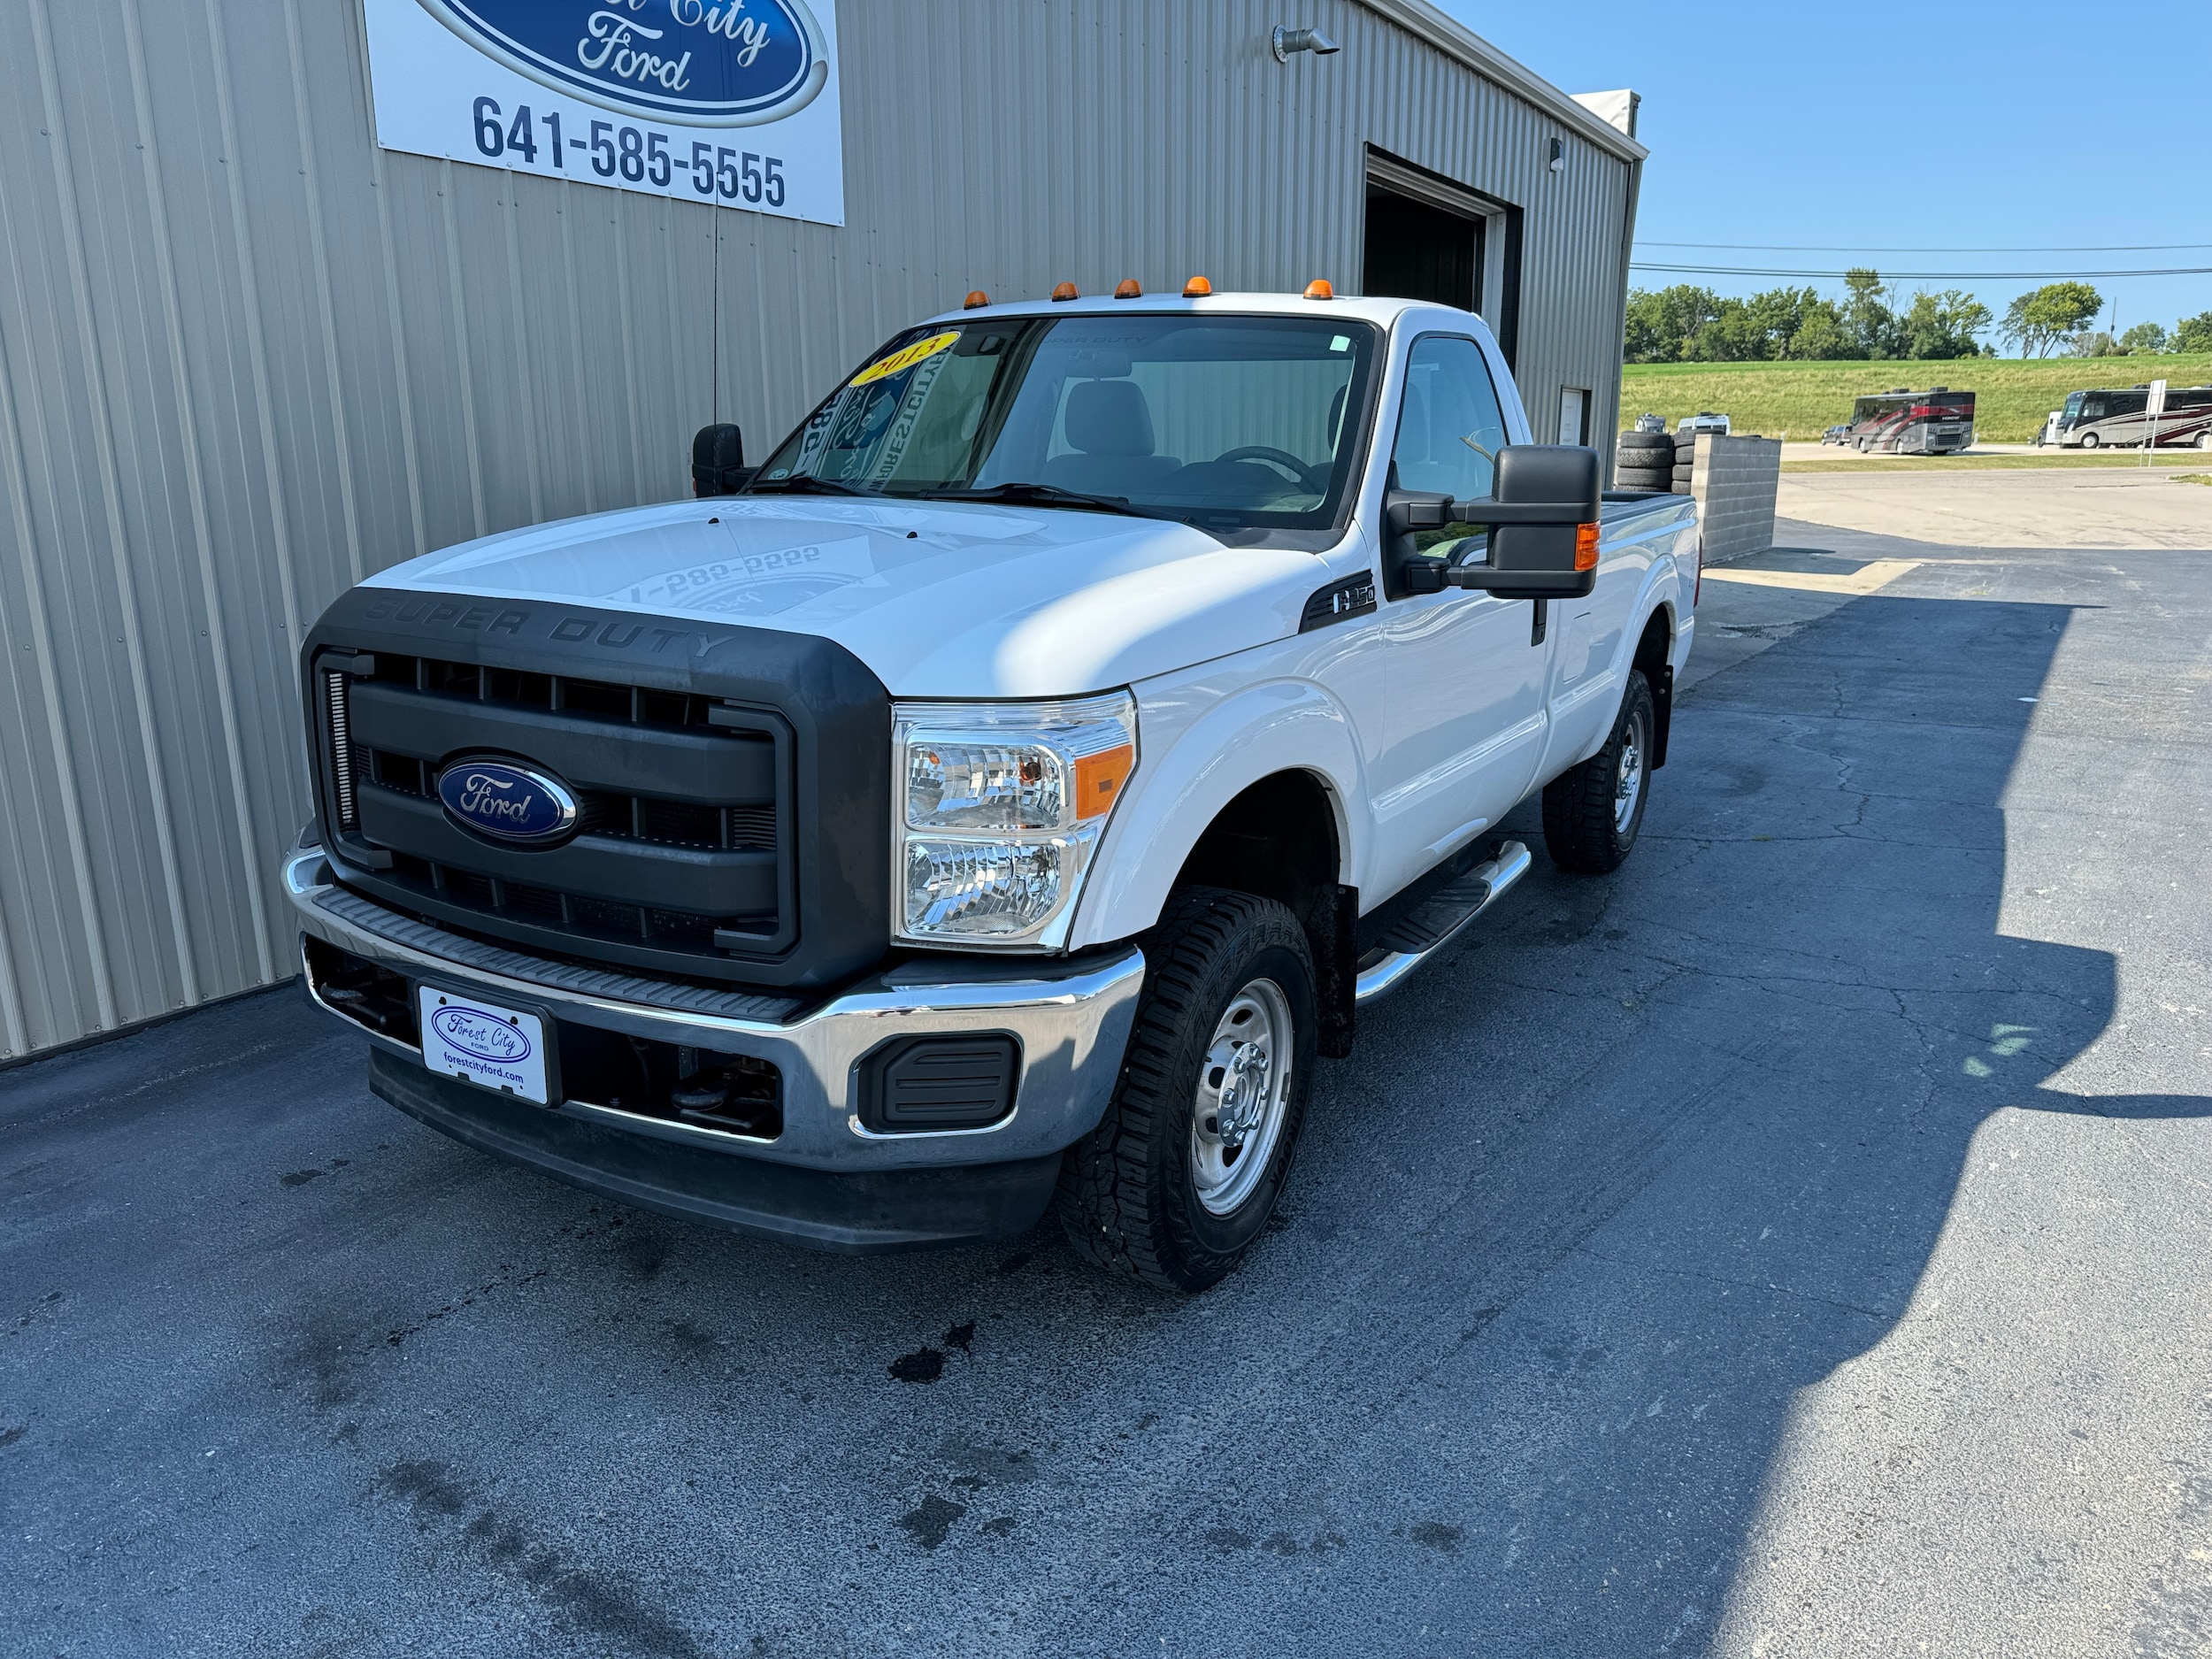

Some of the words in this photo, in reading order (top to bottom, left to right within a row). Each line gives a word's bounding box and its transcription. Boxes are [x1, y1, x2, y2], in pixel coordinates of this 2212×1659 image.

[577, 11, 692, 91] Ford
[472, 96, 785, 207] 641-585-5555
[865, 337, 941, 380] 2013
[363, 596, 531, 634] SUPER
[548, 616, 736, 658] DUTY
[460, 773, 532, 824] Ford
[447, 1014, 488, 1041] Forest
[491, 1027, 516, 1056] City
[471, 1041, 489, 1051] FORD
[443, 1051, 524, 1084] forestcityford.com
